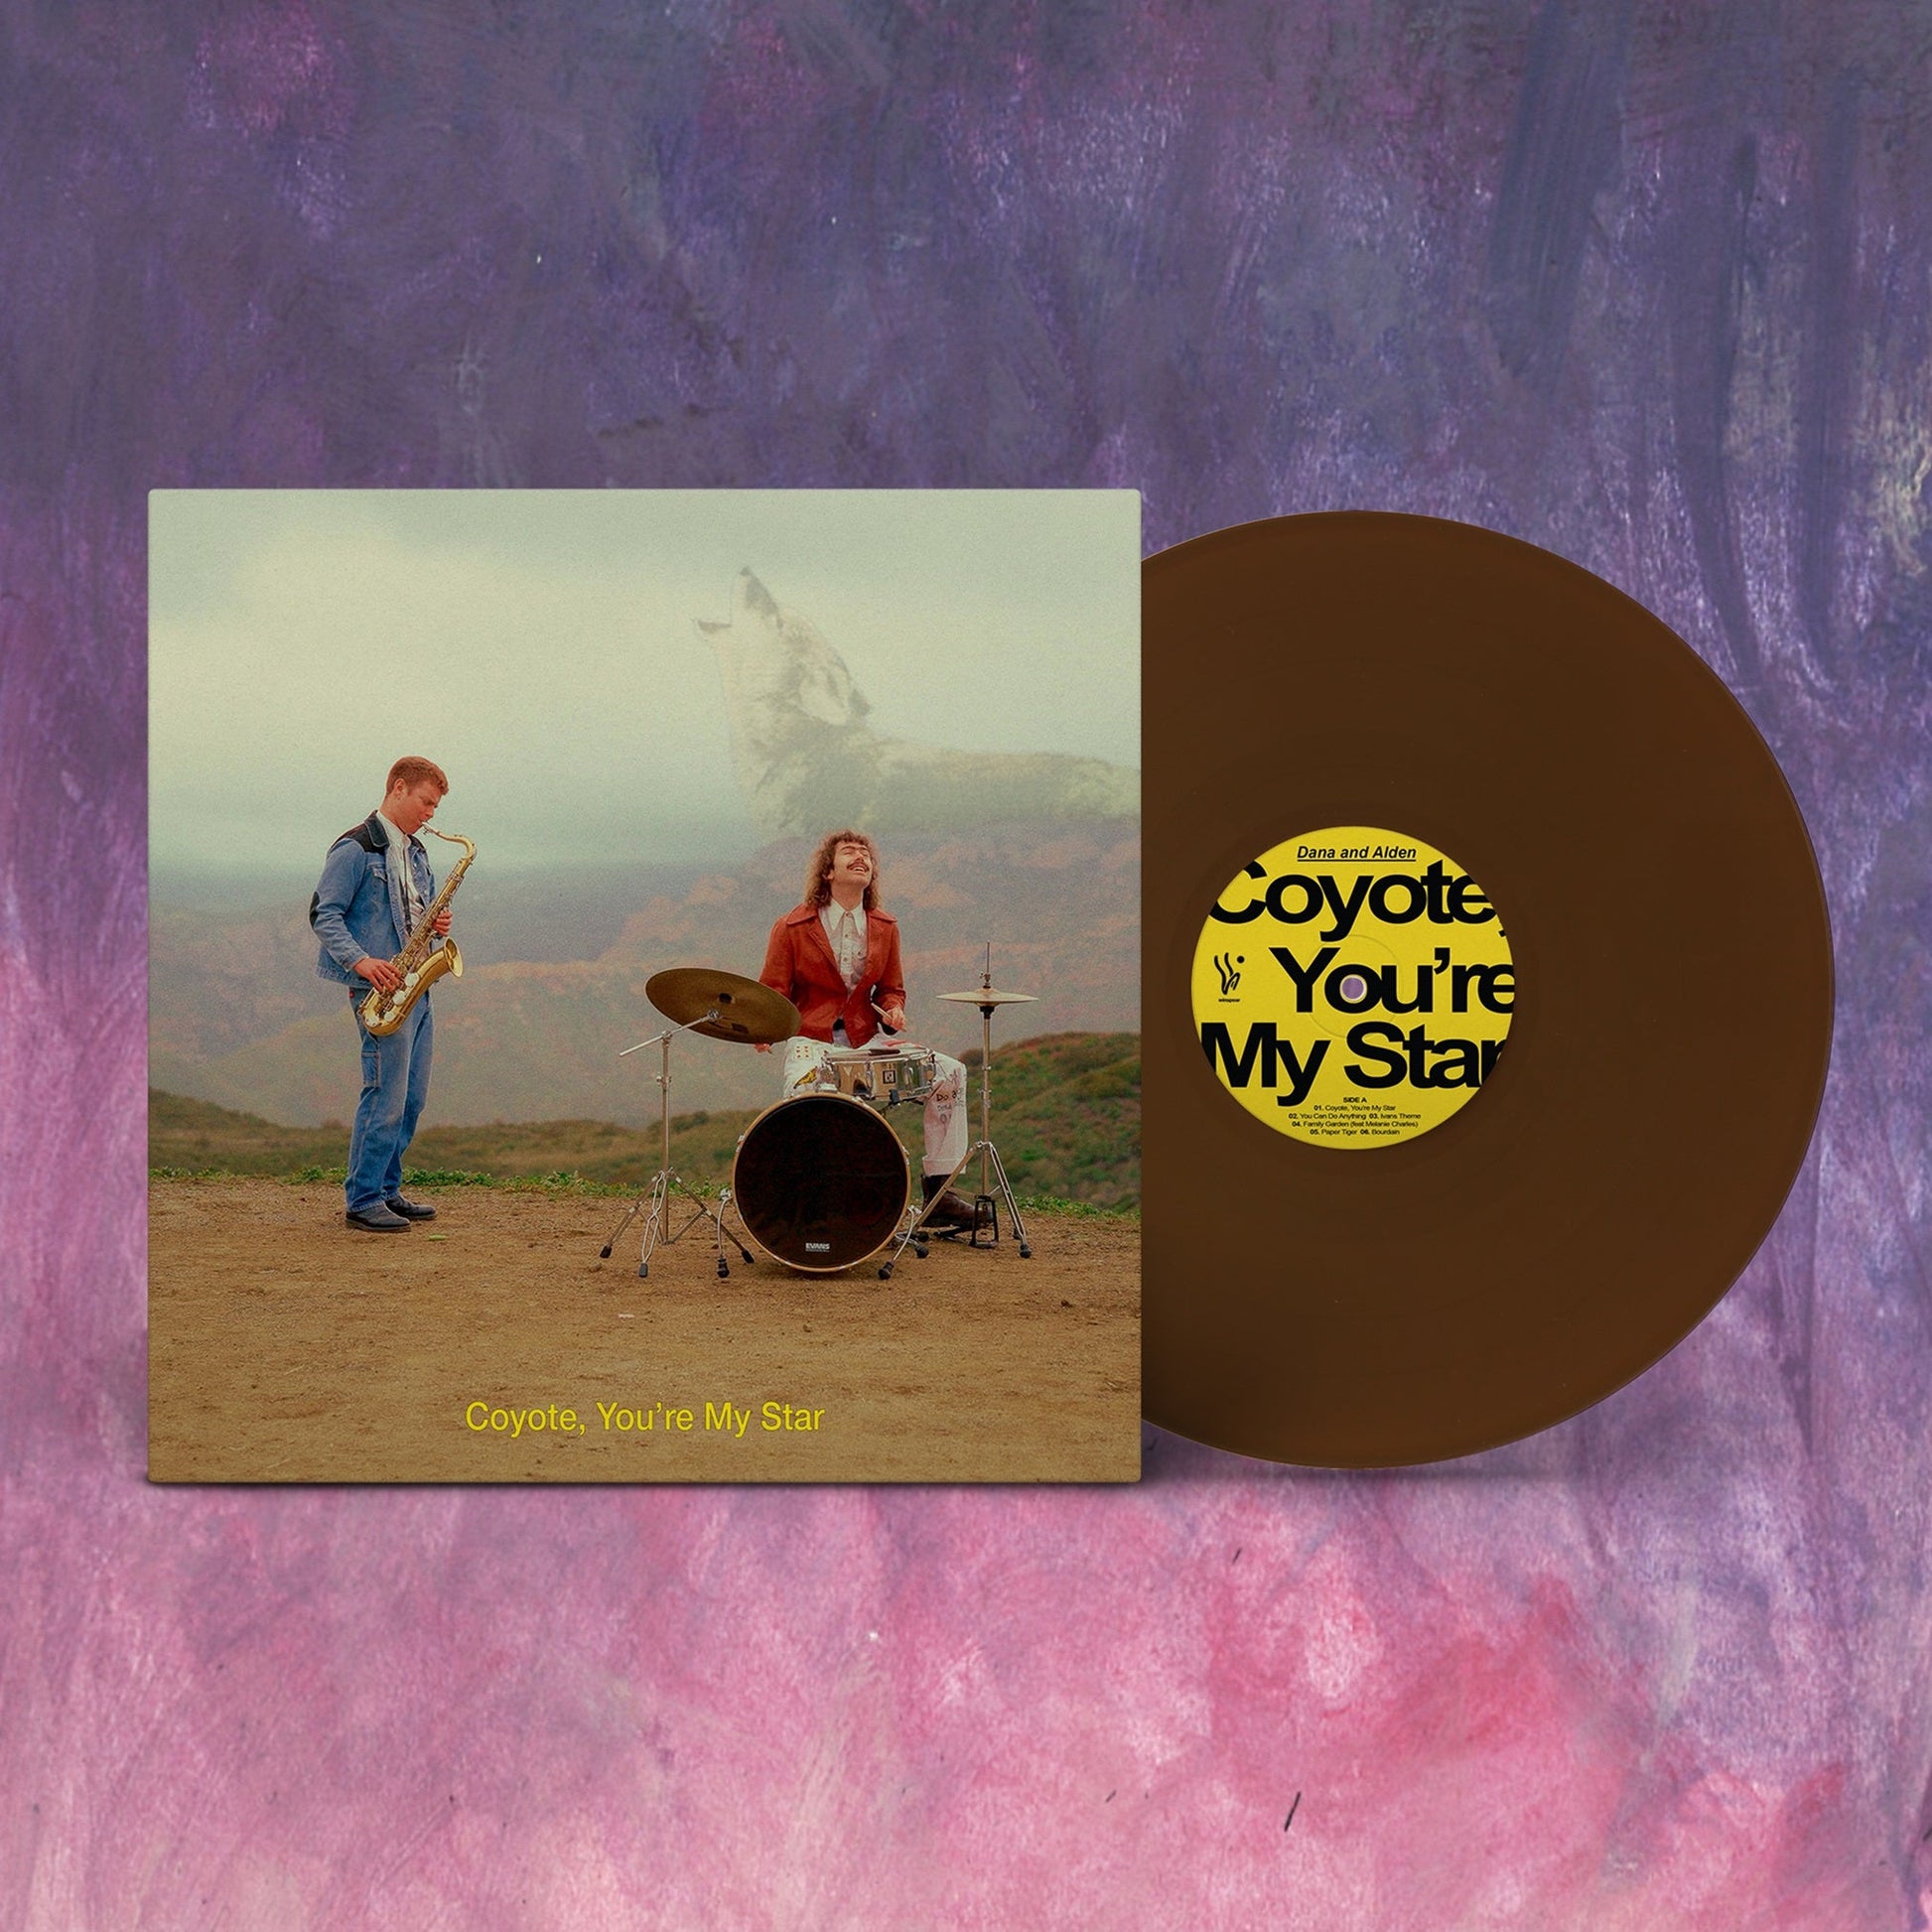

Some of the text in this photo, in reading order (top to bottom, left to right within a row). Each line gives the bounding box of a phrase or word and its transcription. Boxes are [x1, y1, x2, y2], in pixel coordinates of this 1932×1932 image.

[1297, 846, 1417, 859] Dana and Alden
[1208, 860, 1506, 942] Coyote
[1269, 947, 1515, 1014] You’re
[1201, 1022, 1507, 1107] My Star
[466, 1401, 825, 1439] Coyote, You’re My Star
